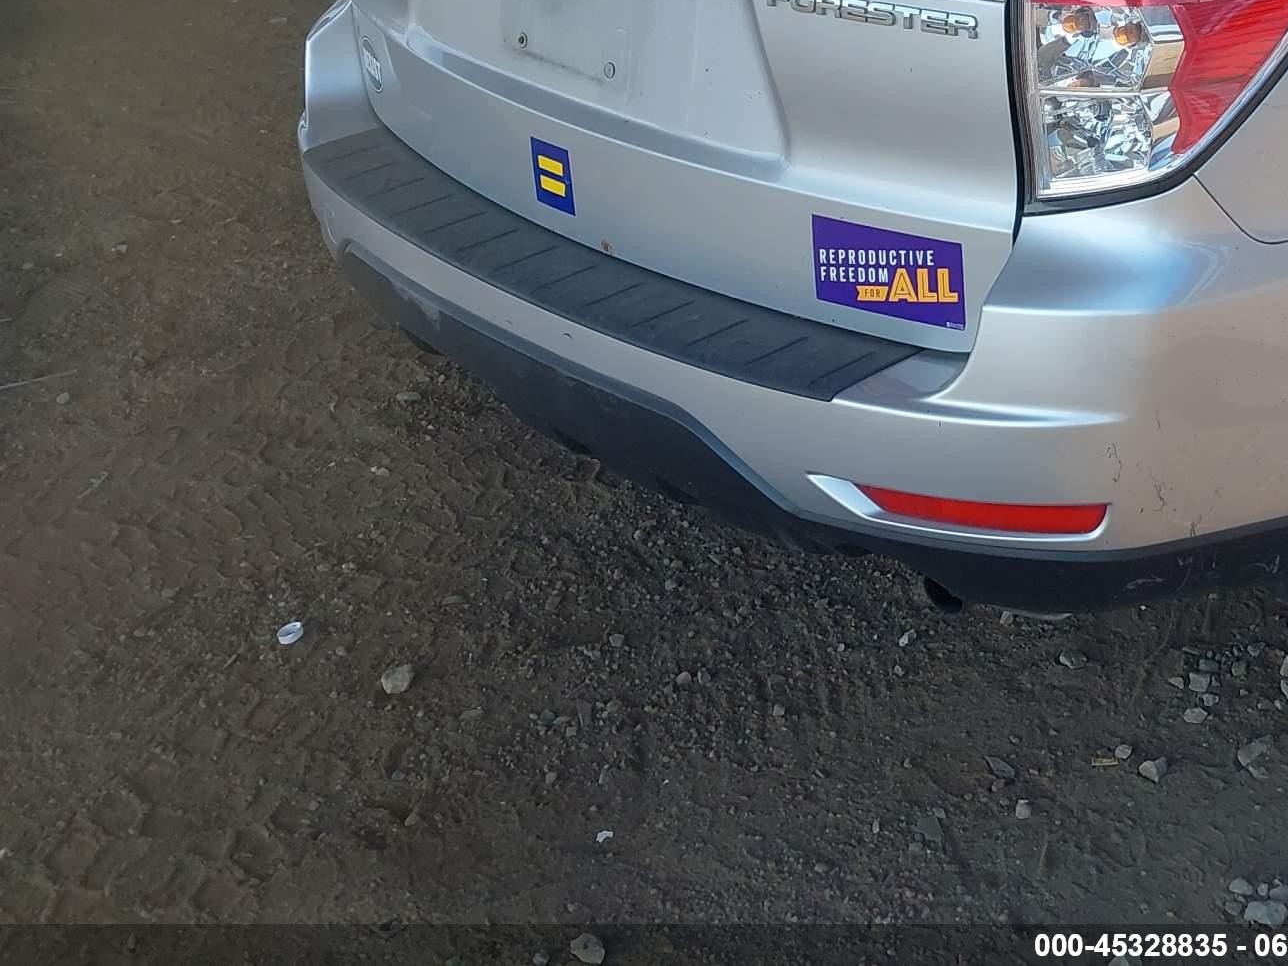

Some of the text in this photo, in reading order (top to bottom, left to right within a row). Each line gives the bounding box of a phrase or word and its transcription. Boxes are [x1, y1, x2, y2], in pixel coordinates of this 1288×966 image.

[819, 249, 934, 266] REPRODUCTIVE
[820, 266, 889, 283] FREEDOM
[864, 268, 959, 303] FOR ALL
